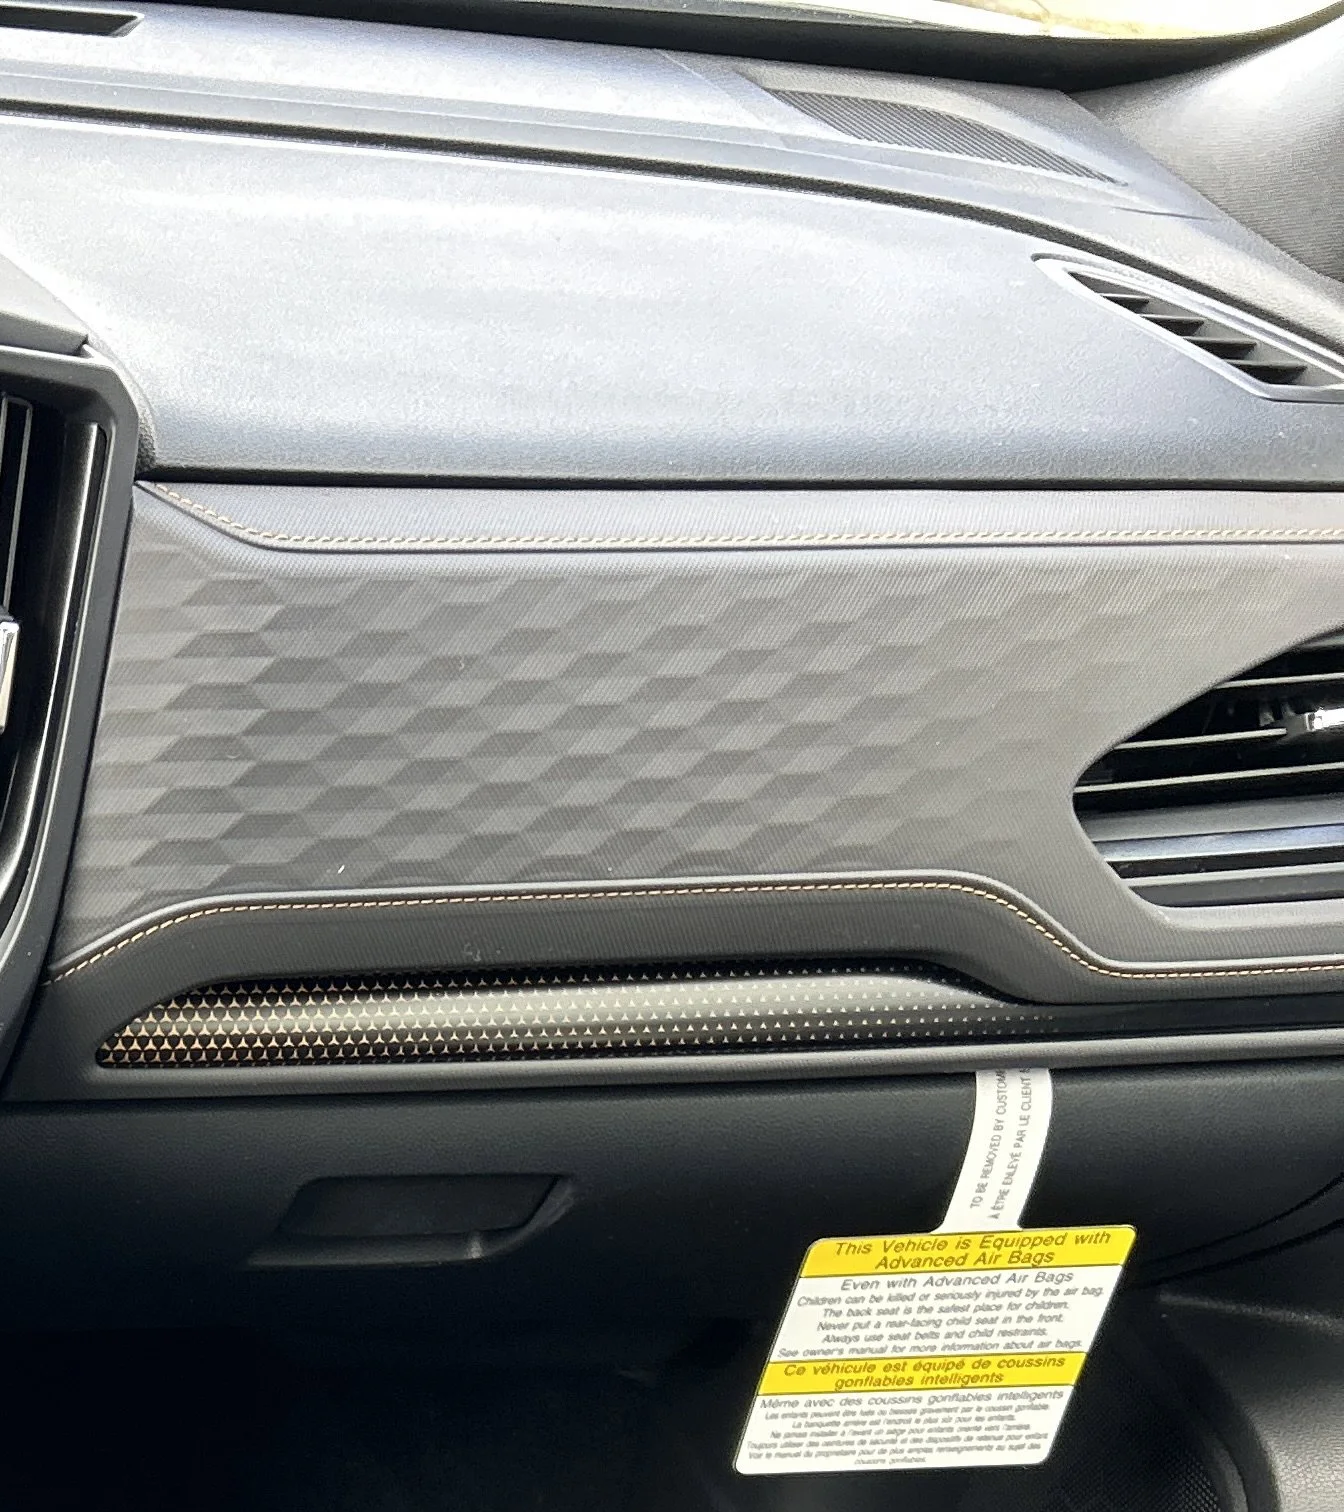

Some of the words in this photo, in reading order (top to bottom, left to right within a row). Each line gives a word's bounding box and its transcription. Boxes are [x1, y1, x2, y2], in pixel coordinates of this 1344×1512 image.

[1020, 1076, 1032, 1111] CLIENT
[993, 1118, 1004, 1132] BY
[1019, 1114, 1030, 1127] LE
[1013, 1129, 1027, 1149] PAR
[980, 1134, 1002, 1180] REMOVED
[975, 1182, 988, 1194] BE
[970, 1195, 984, 1209] TO
[836, 1240, 873, 1256] This
[883, 1238, 949, 1253] Vehicle
[955, 1237, 972, 1250] is
[979, 1232, 1068, 1251] Equipped
[1075, 1231, 1111, 1245] with
[875, 1253, 969, 1270] Advanced
[973, 1252, 1003, 1266] Air
[1007, 1250, 1055, 1268] Bags
[841, 1278, 880, 1291] Even
[887, 1277, 918, 1289] with
[923, 1273, 1002, 1288] Advanced
[1005, 1272, 1029, 1284] Air
[1034, 1271, 1074, 1286] Bags
[797, 1295, 841, 1307] Children
[845, 1296, 865, 1304] can
[868, 1294, 883, 1304] be
[887, 1292, 916, 1302] killed
[918, 1293, 931, 1301] or
[934, 1289, 982, 1301] seriously
[985, 1288, 1023, 1300] injured
[1025, 1288, 1040, 1299] by
[1042, 1287, 1061, 1297] the
[1063, 1287, 1079, 1296] air
[823, 1308, 843, 1318] The
[846, 1307, 872, 1317] back
[876, 1306, 900, 1316] seat
[903, 1305, 913, 1315] is
[916, 1304, 934, 1314] the
[937, 1303, 971, 1314] safest
[973, 1302, 1003, 1314] place
[1006, 1301, 1023, 1311] for
[784, 1363, 807, 1377] Ce
[813, 1361, 877, 1375] véhicule
[882, 1361, 908, 1373] est
[912, 1358, 965, 1374] équipé
[971, 1358, 992, 1370] de
[997, 1357, 1066, 1370] coussins
[834, 1375, 914, 1392] gonflables
[920, 1371, 1004, 1388] intelligents
[760, 1397, 800, 1409] Même
[803, 1398, 835, 1408] avec
[839, 1395, 863, 1407] des
[867, 1395, 923, 1407] coussins
[928, 1392, 992, 1406] gonflables
[997, 1390, 1064, 1403] intelligents
